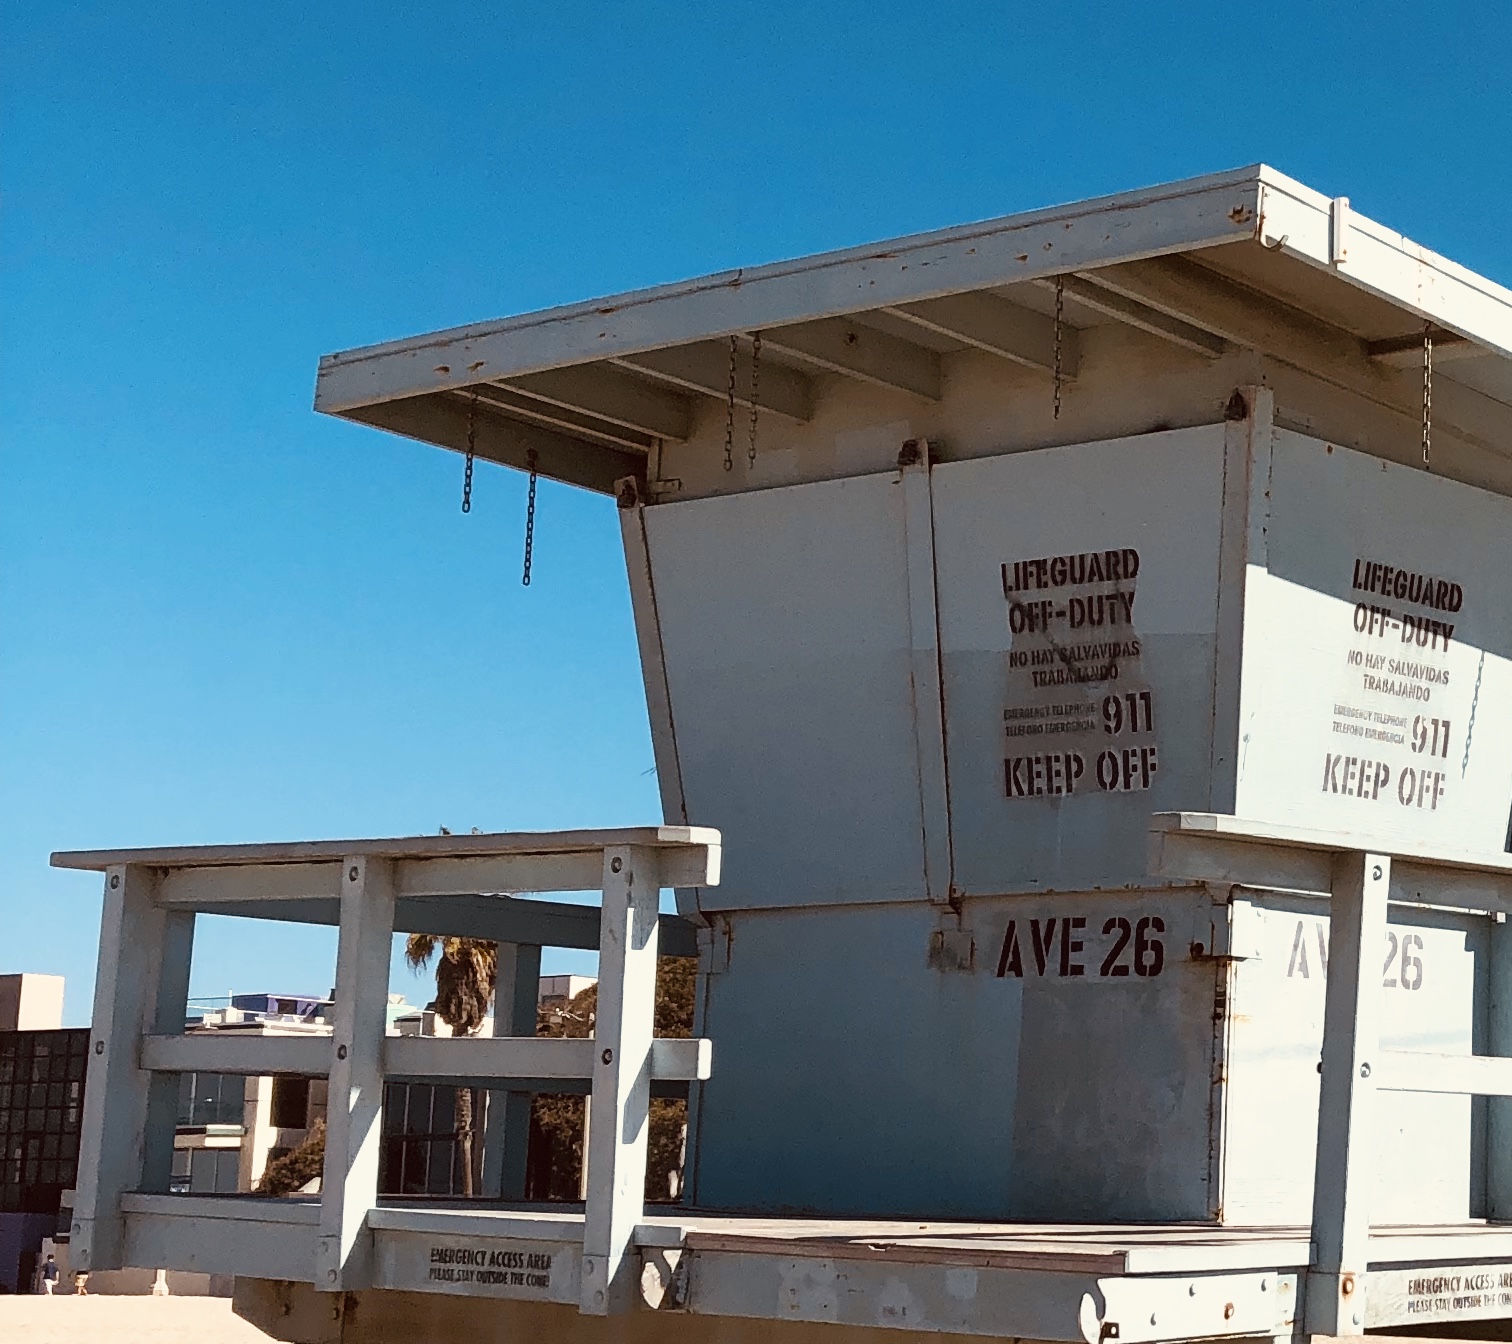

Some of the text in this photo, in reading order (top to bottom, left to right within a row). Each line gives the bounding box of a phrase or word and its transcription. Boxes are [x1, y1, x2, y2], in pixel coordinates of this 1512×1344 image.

[1001, 548, 1140, 592] LIFEGUARD
[1352, 558, 1463, 613] LIFEGUARD
[1008, 592, 1135, 634] OFF-DUTY
[1353, 603, 1455, 652] OFF-DUTY
[1009, 640, 1140, 668] NO HAY SALVAVIDAS
[1347, 649, 1450, 685] NO HAY SALVAVIDAS
[1363, 674, 1431, 702] TRABAJANDO
[1102, 691, 1154, 734] 911
[1332, 720, 1364, 737] TELEFONO
[1333, 704, 1408, 728] EMERGENCY TELEPHONE
[1411, 715, 1451, 758] 911
[1004, 747, 1157, 797] KEEP OFF
[1322, 752, 1446, 810] KEEP OFF
[996, 915, 1165, 978] AVE 26
[1287, 920, 1424, 991] AV 26
[429, 1267, 455, 1281] PLEASE
[456, 1268, 474, 1282] STAY
[476, 1270, 508, 1285] OUTSIDE
[510, 1271, 524, 1286] THE
[430, 1248, 552, 1270] EMERGENCY ACCESS AREA
[1407, 1298, 1433, 1313] PLEASE
[1434, 1296, 1451, 1312] STAY
[1453, 1295, 1482, 1309] OUTSIDE
[1408, 1276, 1462, 1295] EMERGENCY
[1464, 1274, 1495, 1291] ACCESS
